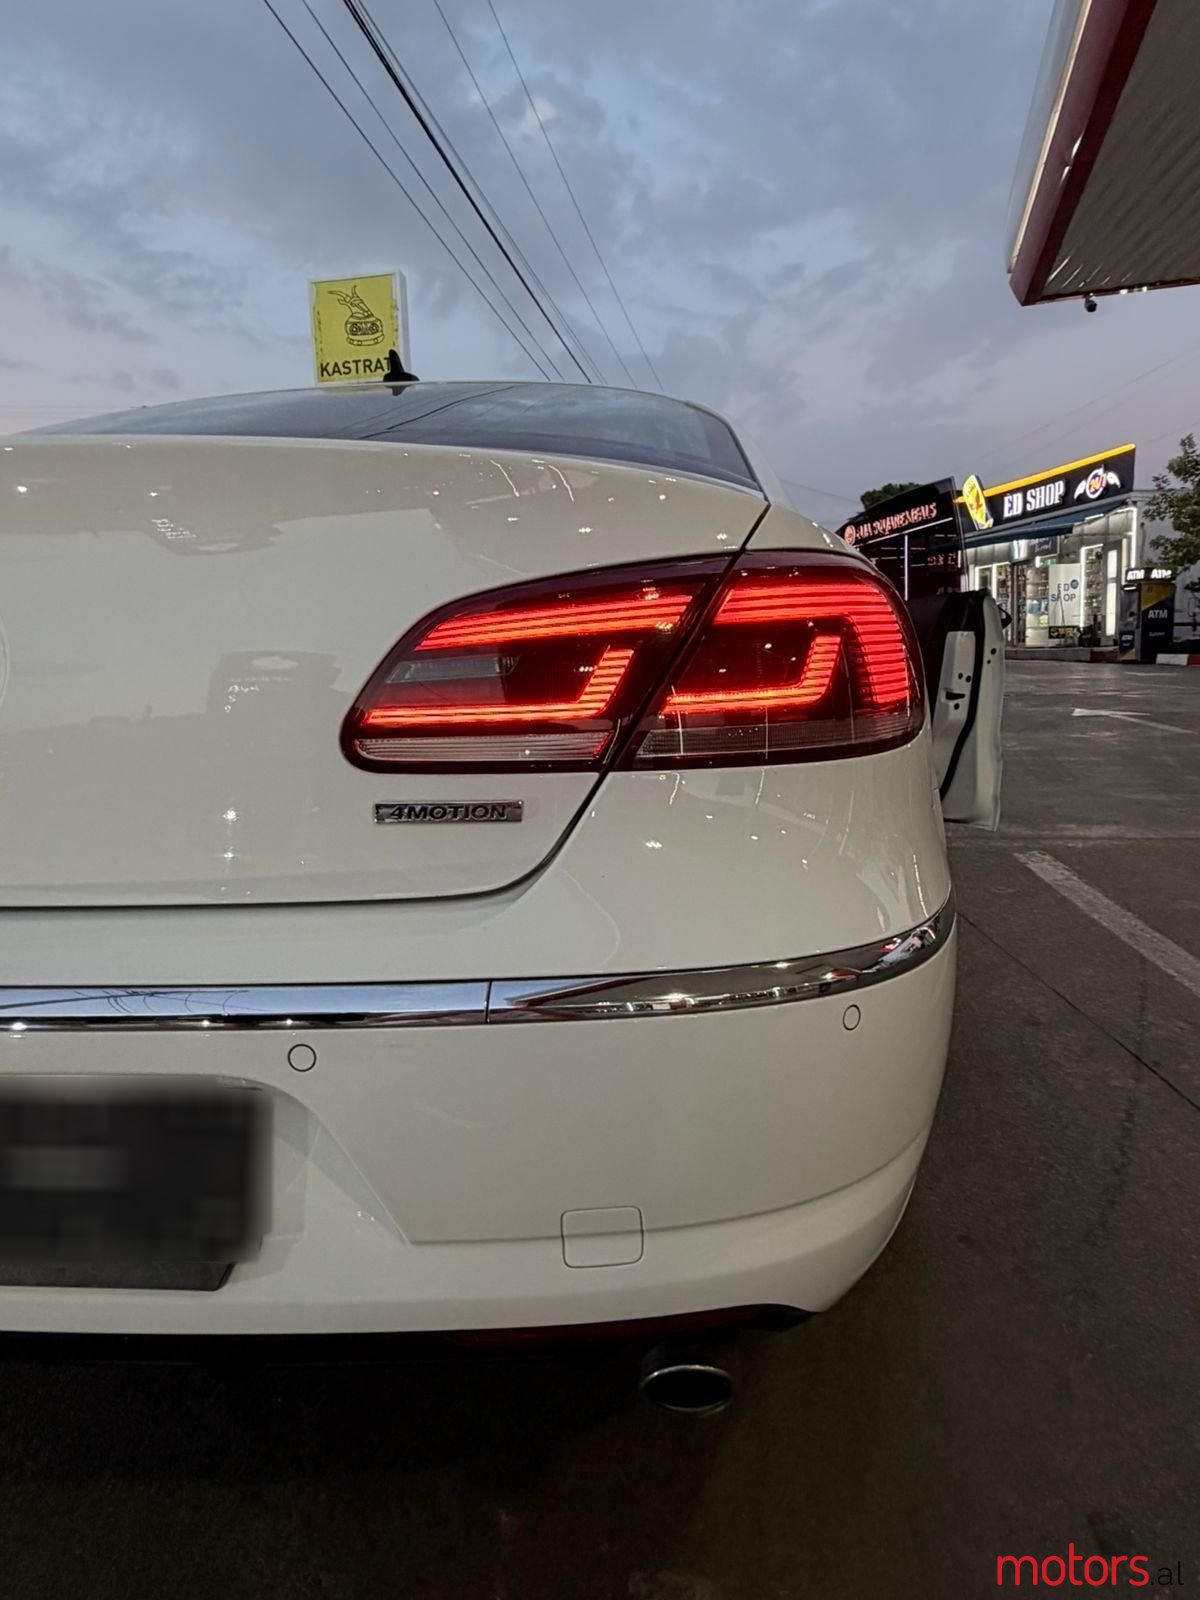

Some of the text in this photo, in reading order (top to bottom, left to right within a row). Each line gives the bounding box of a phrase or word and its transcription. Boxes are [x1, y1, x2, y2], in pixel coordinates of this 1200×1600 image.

[1003, 480, 1065, 518] ED SHOP
[1126, 569, 1145, 581] ATM
[1148, 609, 1168, 619] ATM
[389, 804, 507, 821] 4MOTION
